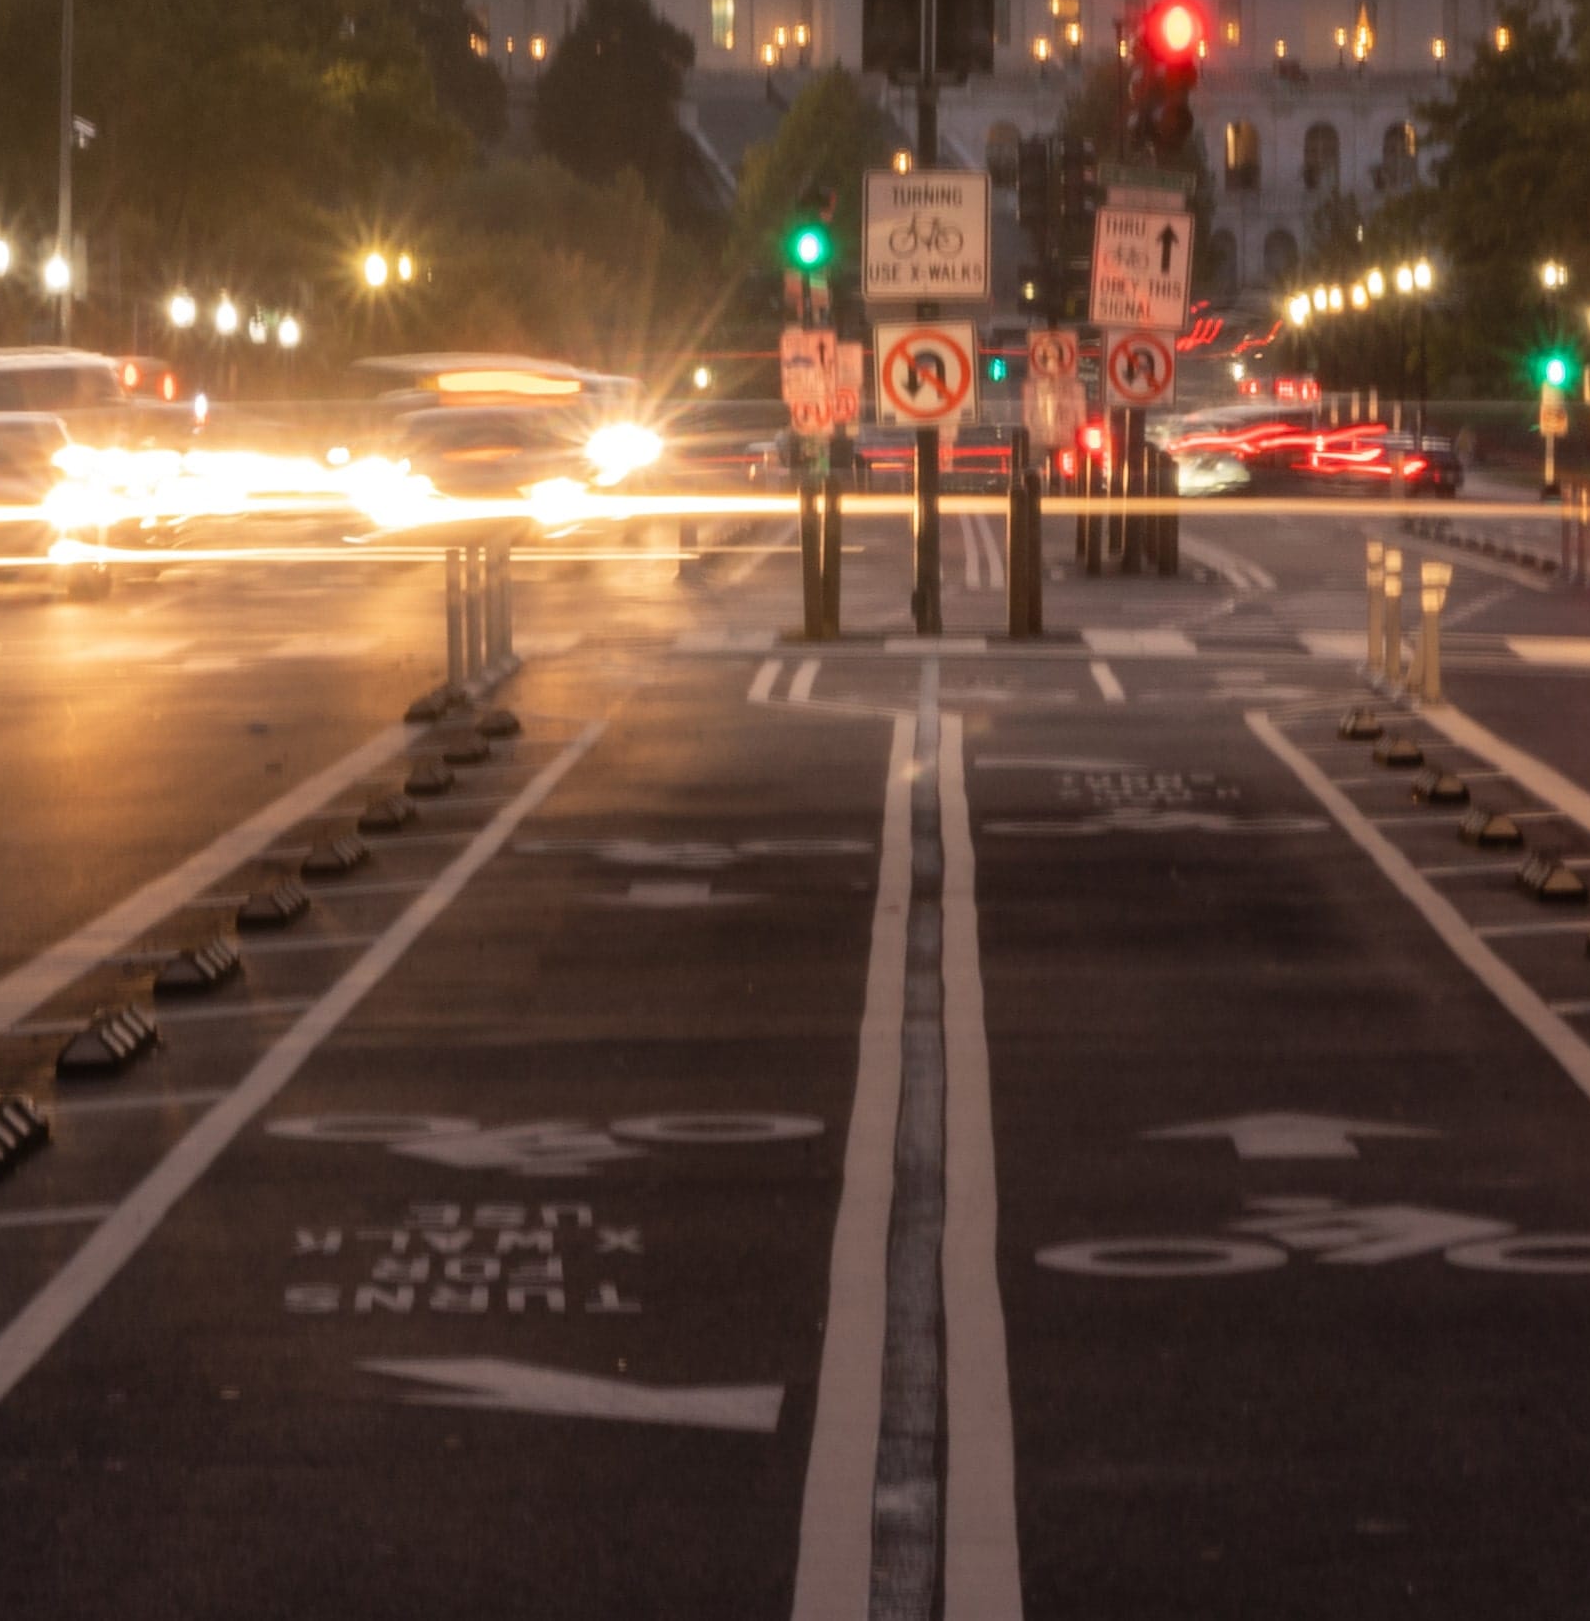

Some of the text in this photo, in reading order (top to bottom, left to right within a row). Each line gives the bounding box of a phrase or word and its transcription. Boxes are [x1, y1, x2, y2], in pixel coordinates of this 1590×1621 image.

[891, 185, 963, 207] TURNING
[1106, 217, 1147, 237] THRU
[869, 263, 898, 283] USE
[1100, 276, 1182, 300] OBEY THIS
[1098, 299, 1152, 320] SIGNAL
[294, 1228, 555, 1254] WALK
[372, 1254, 564, 1282] FOR
[284, 1282, 642, 1314] TURNS
